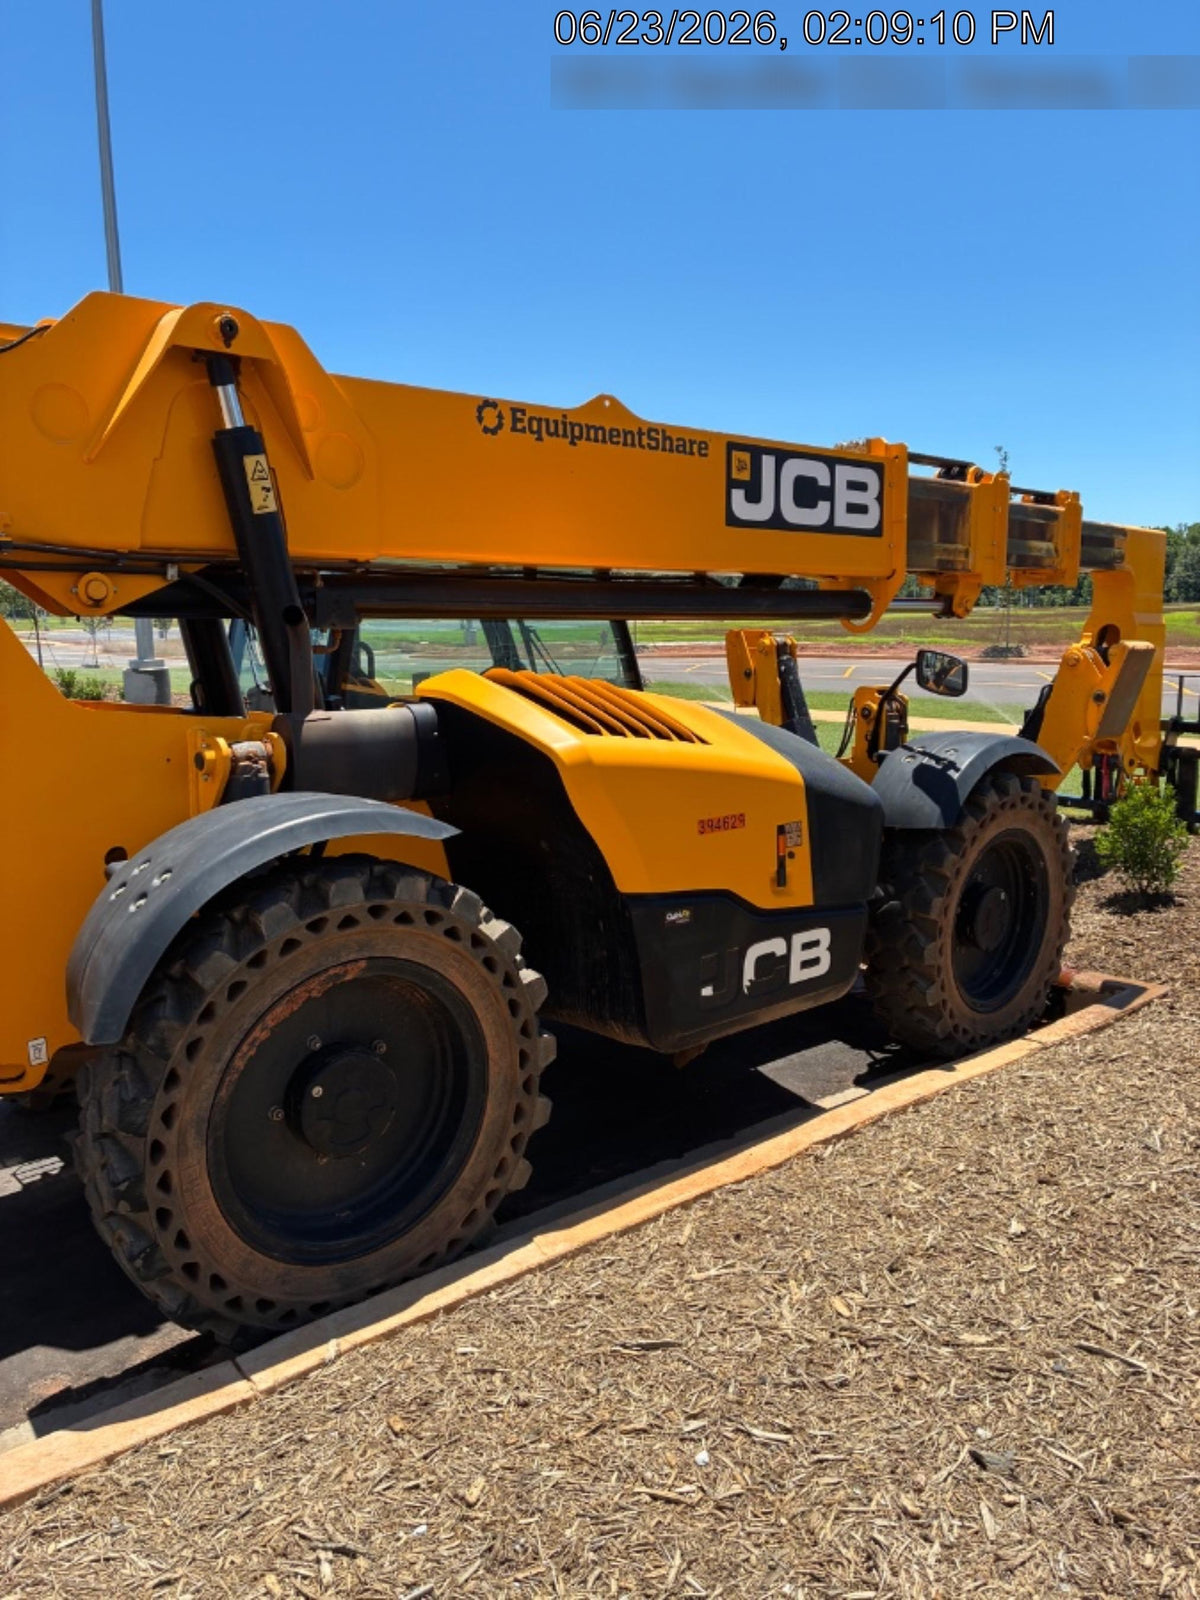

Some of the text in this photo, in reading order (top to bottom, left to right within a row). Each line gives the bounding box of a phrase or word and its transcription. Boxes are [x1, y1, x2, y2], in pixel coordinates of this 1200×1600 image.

[510, 407, 709, 457] EquipmentShare
[730, 454, 881, 530] JCB
[697, 813, 746, 835] 394629
